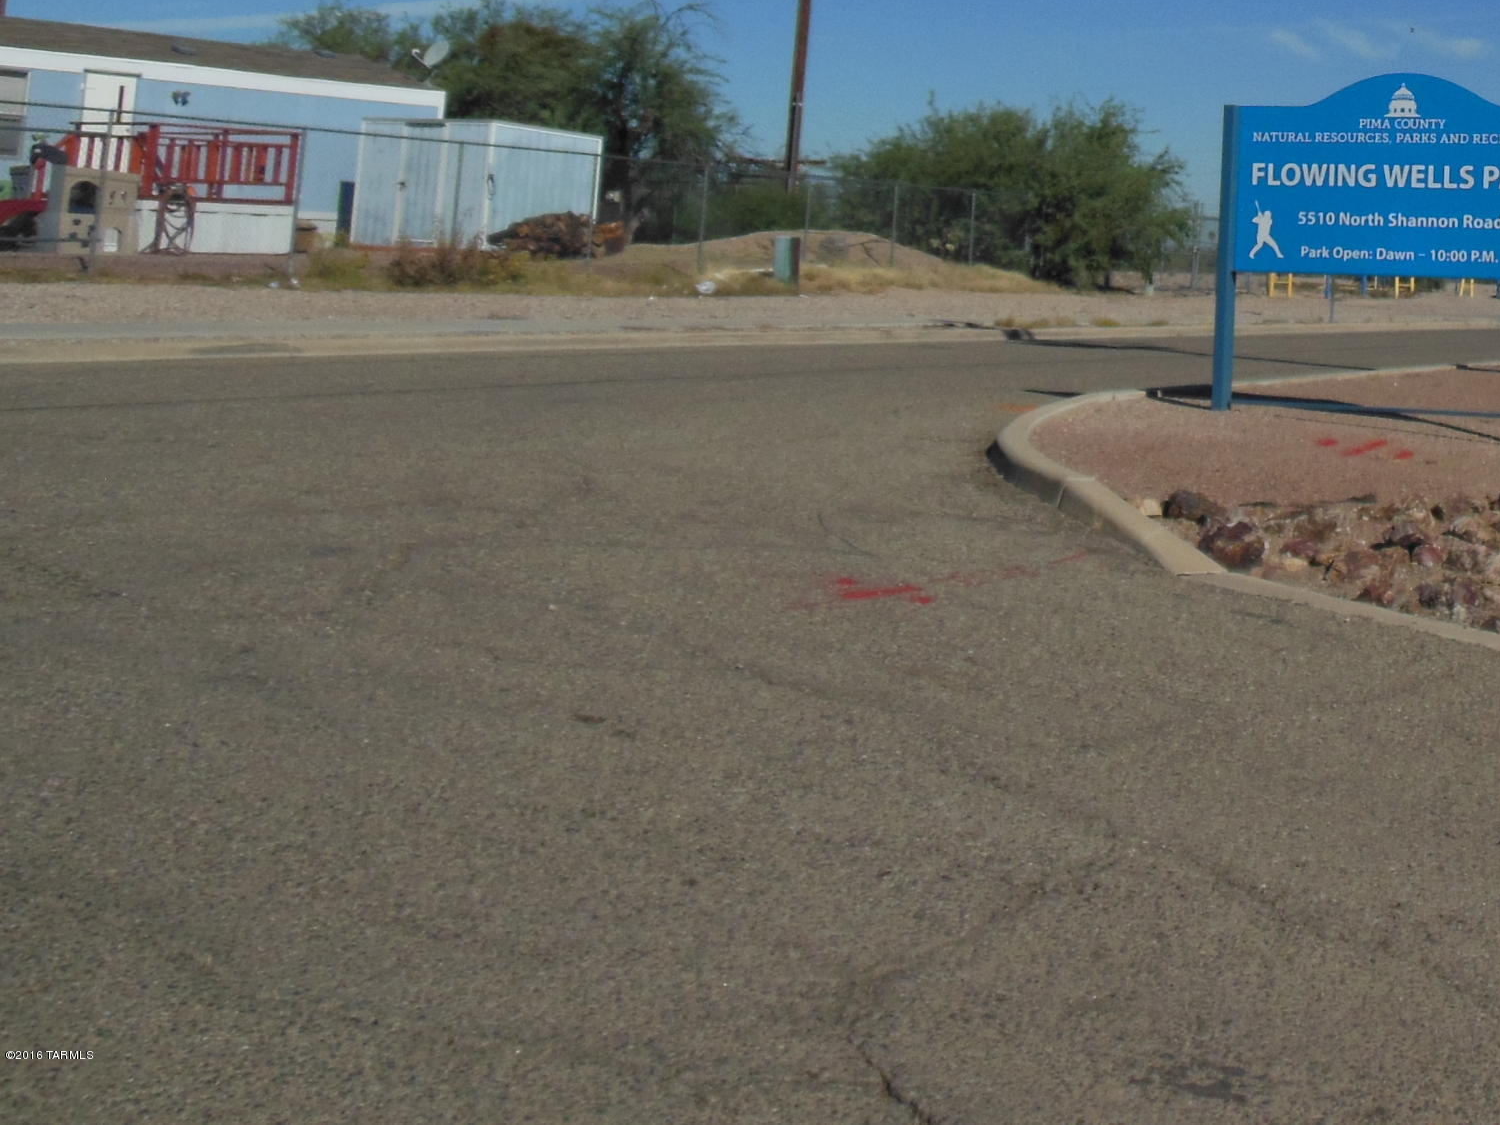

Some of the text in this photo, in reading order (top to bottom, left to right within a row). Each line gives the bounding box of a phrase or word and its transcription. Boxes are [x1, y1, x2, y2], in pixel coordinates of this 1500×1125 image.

[1359, 118, 1446, 129] PIMA COUNTY
[1252, 131, 1312, 143] NATURAL
[1314, 132, 1392, 144] RESOURCES,
[1396, 133, 1437, 144] PARKS
[1440, 133, 1469, 144] AND
[1251, 162, 1377, 188] FLOWING
[1383, 164, 1475, 189] WELLS
[1298, 211, 1335, 225] 5510
[1339, 212, 1384, 226] North
[1388, 213, 1459, 228] Shannon
[1300, 245, 1330, 259] Park
[1333, 247, 1373, 262] Open:
[1376, 248, 1415, 261] Dawn
[1430, 250, 1467, 262] 10:00
[1471, 250, 1499, 263] P.M.
